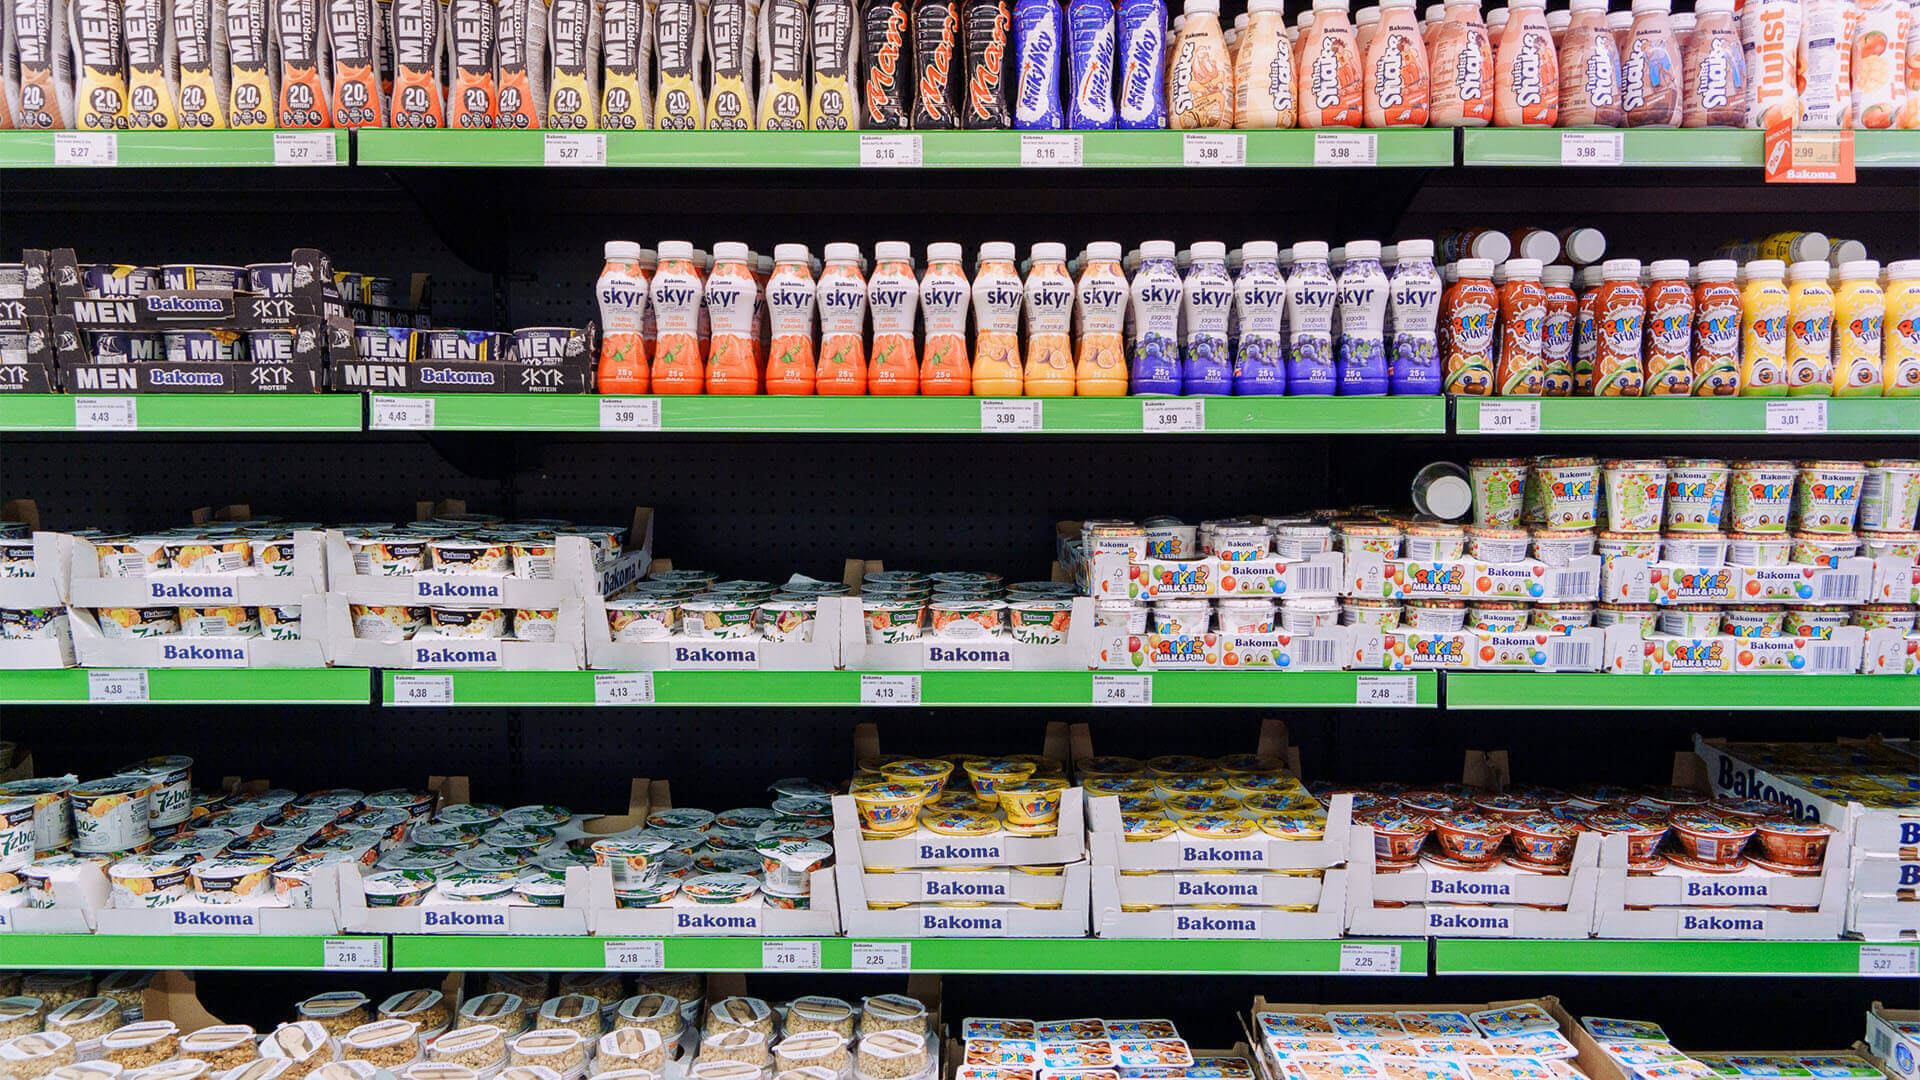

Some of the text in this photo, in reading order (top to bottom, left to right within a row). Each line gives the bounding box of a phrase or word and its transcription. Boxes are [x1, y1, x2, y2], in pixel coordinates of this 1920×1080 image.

[482, 2, 490, 48] PROTEIN
[626, 2, 636, 48] PROTEIN
[679, 3, 688, 49] PROTEIN
[836, 6, 846, 50] PROTEIN
[80, 0, 112, 65] MEN
[125, 0, 150, 64] MEN
[400, 0, 423, 64] MEN
[456, 1, 482, 65] MEN
[556, 1, 575, 66] MEN
[605, 1, 626, 66] MEN
[660, 3, 679, 69] MEN
[714, 4, 732, 70] MEN
[774, 6, 795, 71] MEN
[815, 4, 836, 69] MEN
[868, 2, 907, 120] Mars
[920, 4, 958, 119] Mars
[969, 3, 1012, 119] Mars
[1757, 8, 1784, 104] Twist
[71, 148, 88, 157] 5,27
[291, 148, 308, 158] 5,27
[560, 149, 578, 158] 5,27
[876, 149, 894, 159] 8,16
[1037, 149, 1054, 158] 8,16
[1200, 149, 1218, 158] 3,98
[1331, 148, 1349, 157] 3,98
[1577, 148, 1595, 157] 3,98
[1787, 169, 1836, 180] Bakoma
[603, 288, 644, 308] skyr
[656, 286, 694, 306] skyr
[706, 286, 740, 306] skyr
[773, 289, 812, 308] skyr
[826, 289, 864, 308] skyr
[871, 288, 907, 307] skyr
[925, 288, 962, 308] skyr
[1034, 289, 1070, 308] skyr
[1083, 288, 1122, 307] skyr
[1142, 285, 1181, 305] skyr
[1192, 288, 1231, 308] skyr
[1244, 287, 1283, 307] skyr
[1295, 287, 1334, 307] skyr
[1396, 287, 1437, 307] skyr
[147, 297, 222, 312] Bakoma
[252, 301, 295, 318] SKYR
[75, 302, 136, 322] MEN
[1461, 328, 1491, 344] SHAKE
[1708, 328, 1738, 345] SHAKE
[520, 338, 566, 357] MEN
[76, 368, 138, 389] MEN
[151, 369, 222, 385] Bakoma
[251, 368, 293, 384] SKYR
[344, 366, 406, 387] MEN
[421, 369, 494, 384] Bakoma
[521, 369, 563, 386] SKYR
[91, 412, 109, 421] 4,43
[389, 412, 406, 421] 4,43
[616, 412, 633, 421] 3,99
[997, 414, 1015, 423] 3,99
[1159, 415, 1177, 424] 3,99
[1495, 416, 1511, 425] 3,01
[1782, 415, 1798, 424] 3,01
[443, 552, 470, 560] Bakoma
[1232, 567, 1274, 576] Bakoma
[1488, 568, 1531, 578] Bakoma
[1757, 571, 1800, 580] Bakoma
[152, 583, 232, 597] Bakoma
[419, 582, 498, 596] Bakoma
[1235, 638, 1278, 648] Bakoma
[1492, 637, 1535, 646] Bakoma
[1750, 642, 1794, 650] Bakoma
[165, 646, 244, 659] Bakoma
[417, 649, 496, 662] Bakoma
[676, 648, 755, 661] Bakoma
[930, 648, 1009, 661] Bakoma
[105, 685, 122, 694] 4,38
[409, 689, 427, 698] 4,38
[610, 688, 627, 696] 4,13
[876, 689, 893, 697] 4,13
[1108, 689, 1125, 698] 2,48
[1372, 689, 1389, 698] 2,48
[921, 846, 999, 858] Bakoma
[1184, 848, 1262, 861] Bakoma
[927, 881, 1004, 894] Bakoma
[1179, 882, 1257, 895] Bakoma
[1431, 880, 1509, 894] Bakoma
[1688, 883, 1766, 896] Bakoma
[174, 912, 253, 925] Bakoma
[425, 912, 504, 925] Bakoma
[678, 914, 756, 927] Bakoma
[924, 916, 1001, 929] Bakoma
[1178, 917, 1255, 930] Bakoma
[1430, 914, 1508, 928] Bakoma
[1685, 916, 1763, 929] Bakoma
[339, 953, 356, 961] 2,18
[620, 954, 637, 962] 2,18
[778, 954, 794, 962] 2,18
[867, 956, 883, 965] 2,25
[1355, 958, 1372, 966] 2,25
[1874, 960, 1891, 969] 5,27
